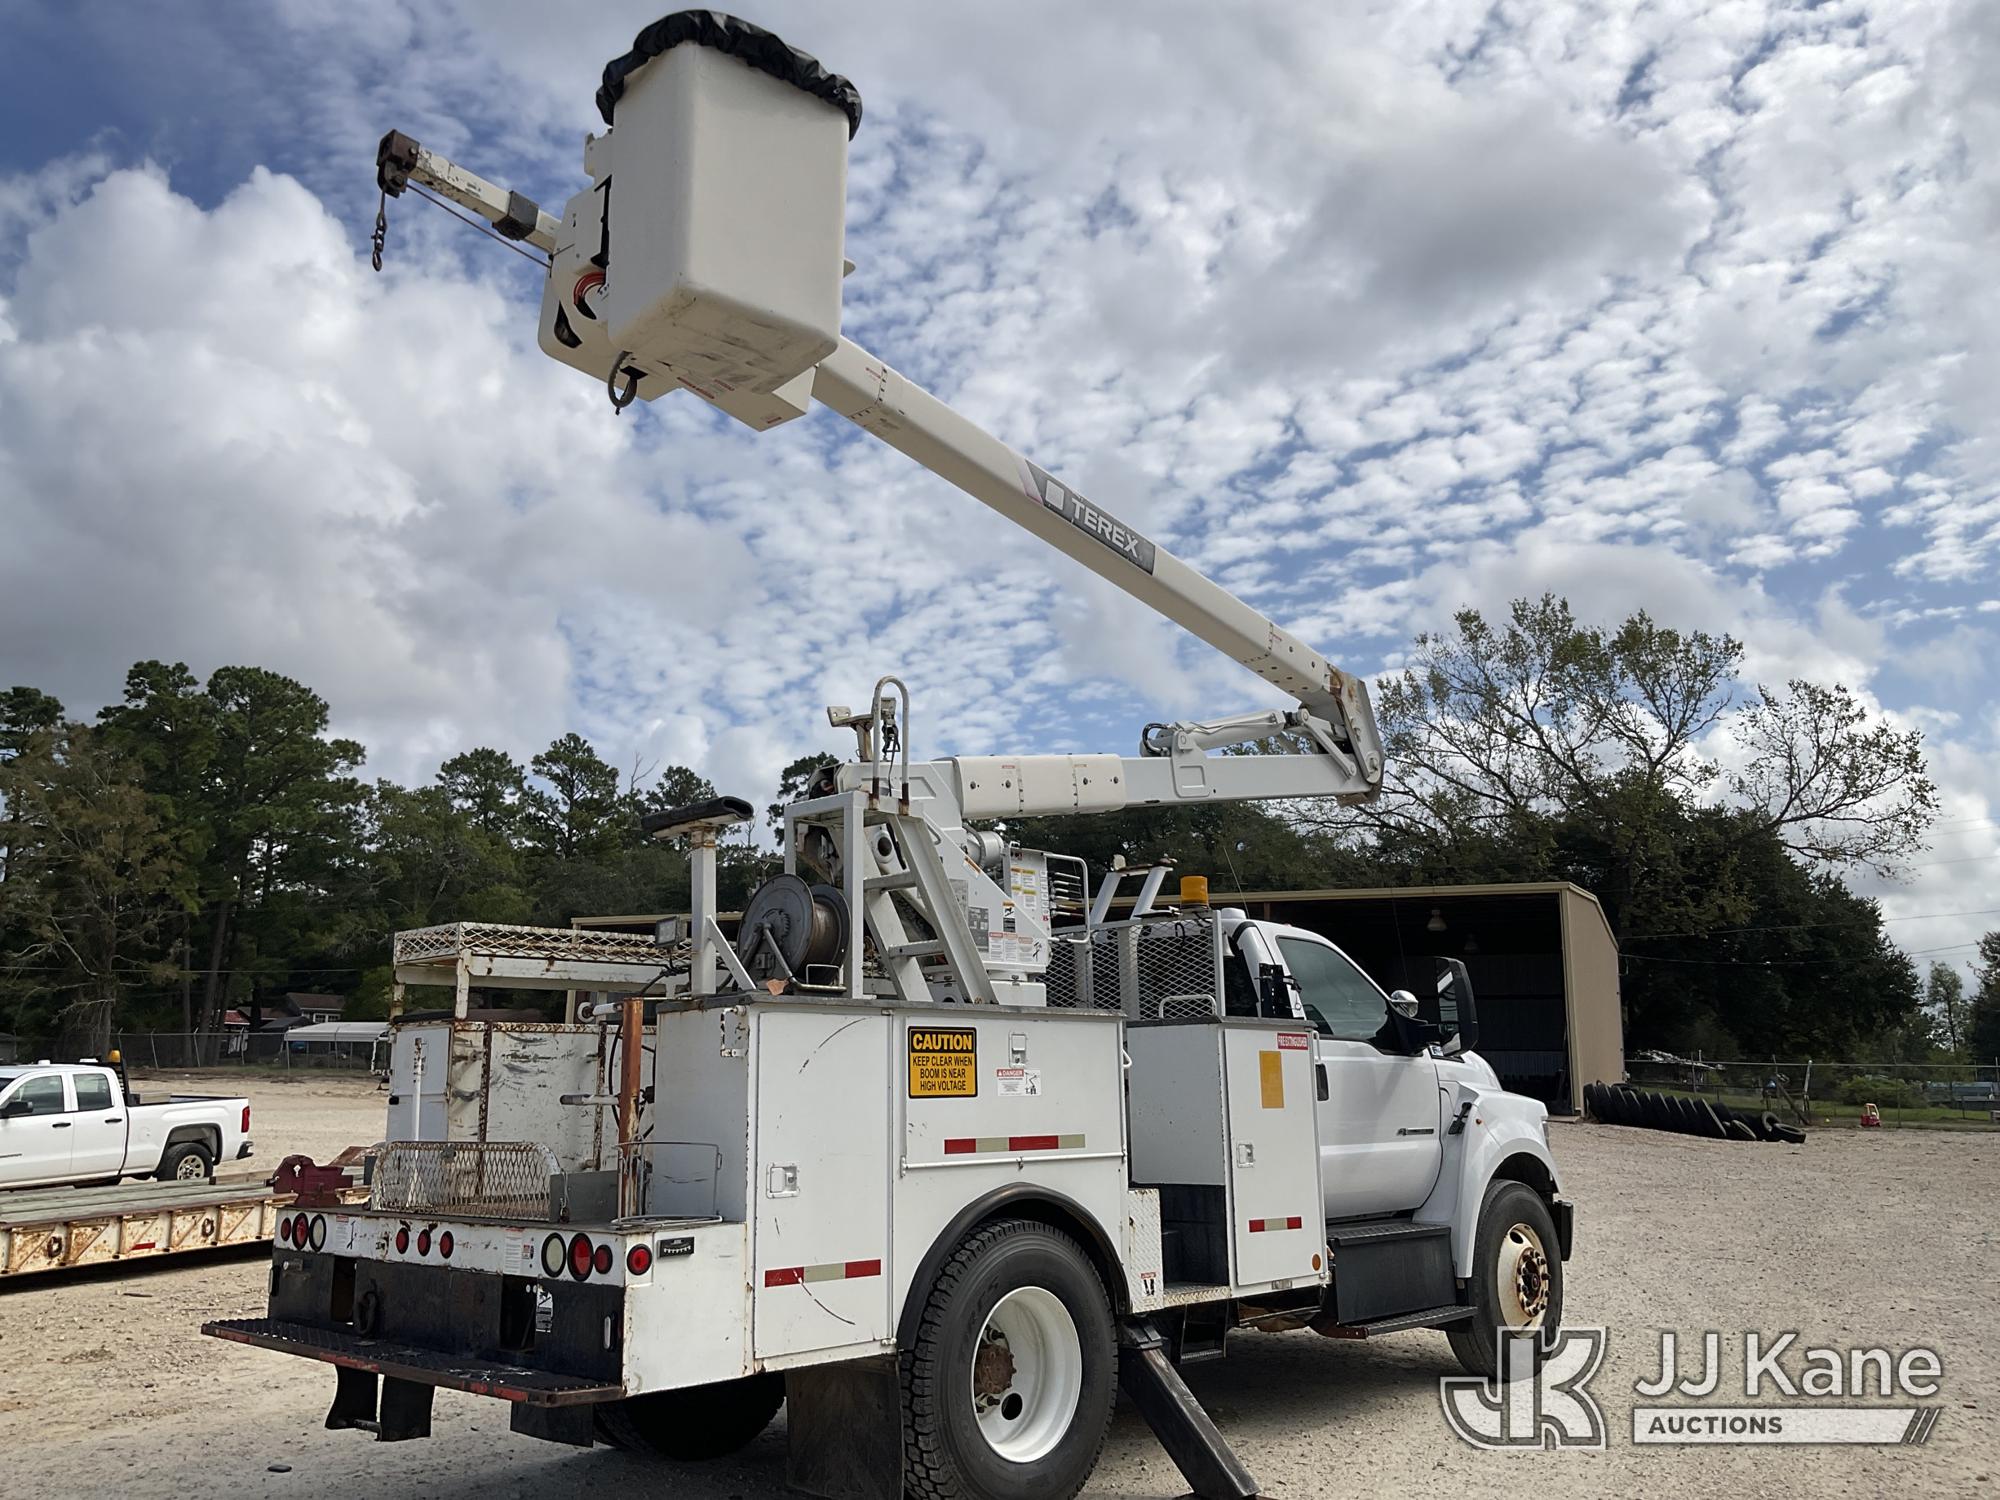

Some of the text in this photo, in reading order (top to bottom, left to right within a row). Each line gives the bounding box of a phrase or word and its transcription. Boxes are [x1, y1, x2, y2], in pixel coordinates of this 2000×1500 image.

[1071, 497, 1139, 558] TEREX
[912, 1033, 973, 1050] CAUTION
[912, 1056, 973, 1066] KEEP CLEAR WHEN
[920, 1068, 966, 1079] BOOM IS NEAR
[920, 1080, 967, 1091] HIGH VOLTAGE
